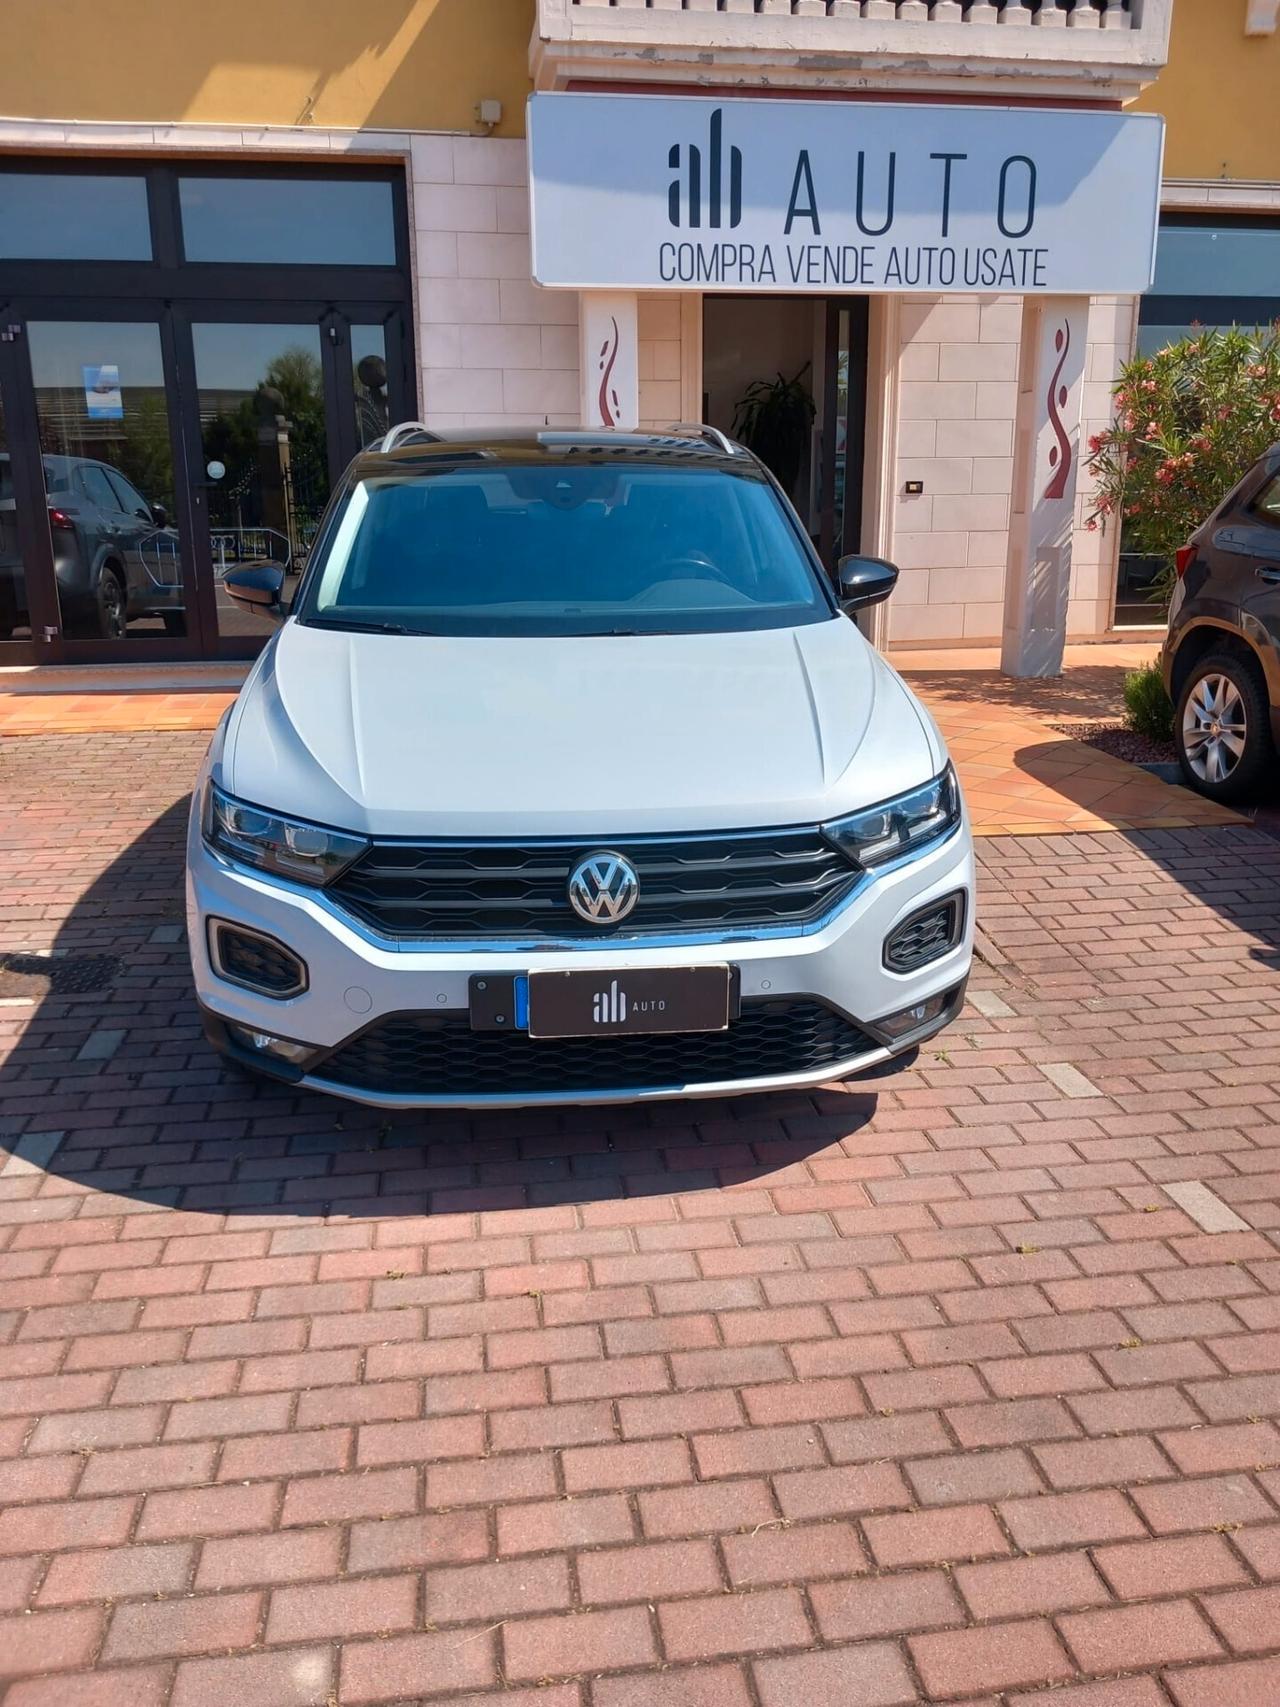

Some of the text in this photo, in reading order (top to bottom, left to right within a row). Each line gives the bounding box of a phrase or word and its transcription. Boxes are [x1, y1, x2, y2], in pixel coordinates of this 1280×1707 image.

[783, 149, 1037, 239] AUTO
[659, 242, 1049, 287] COMPRA VENDE AUTO USATE
[632, 1000, 666, 1012] AUTO
